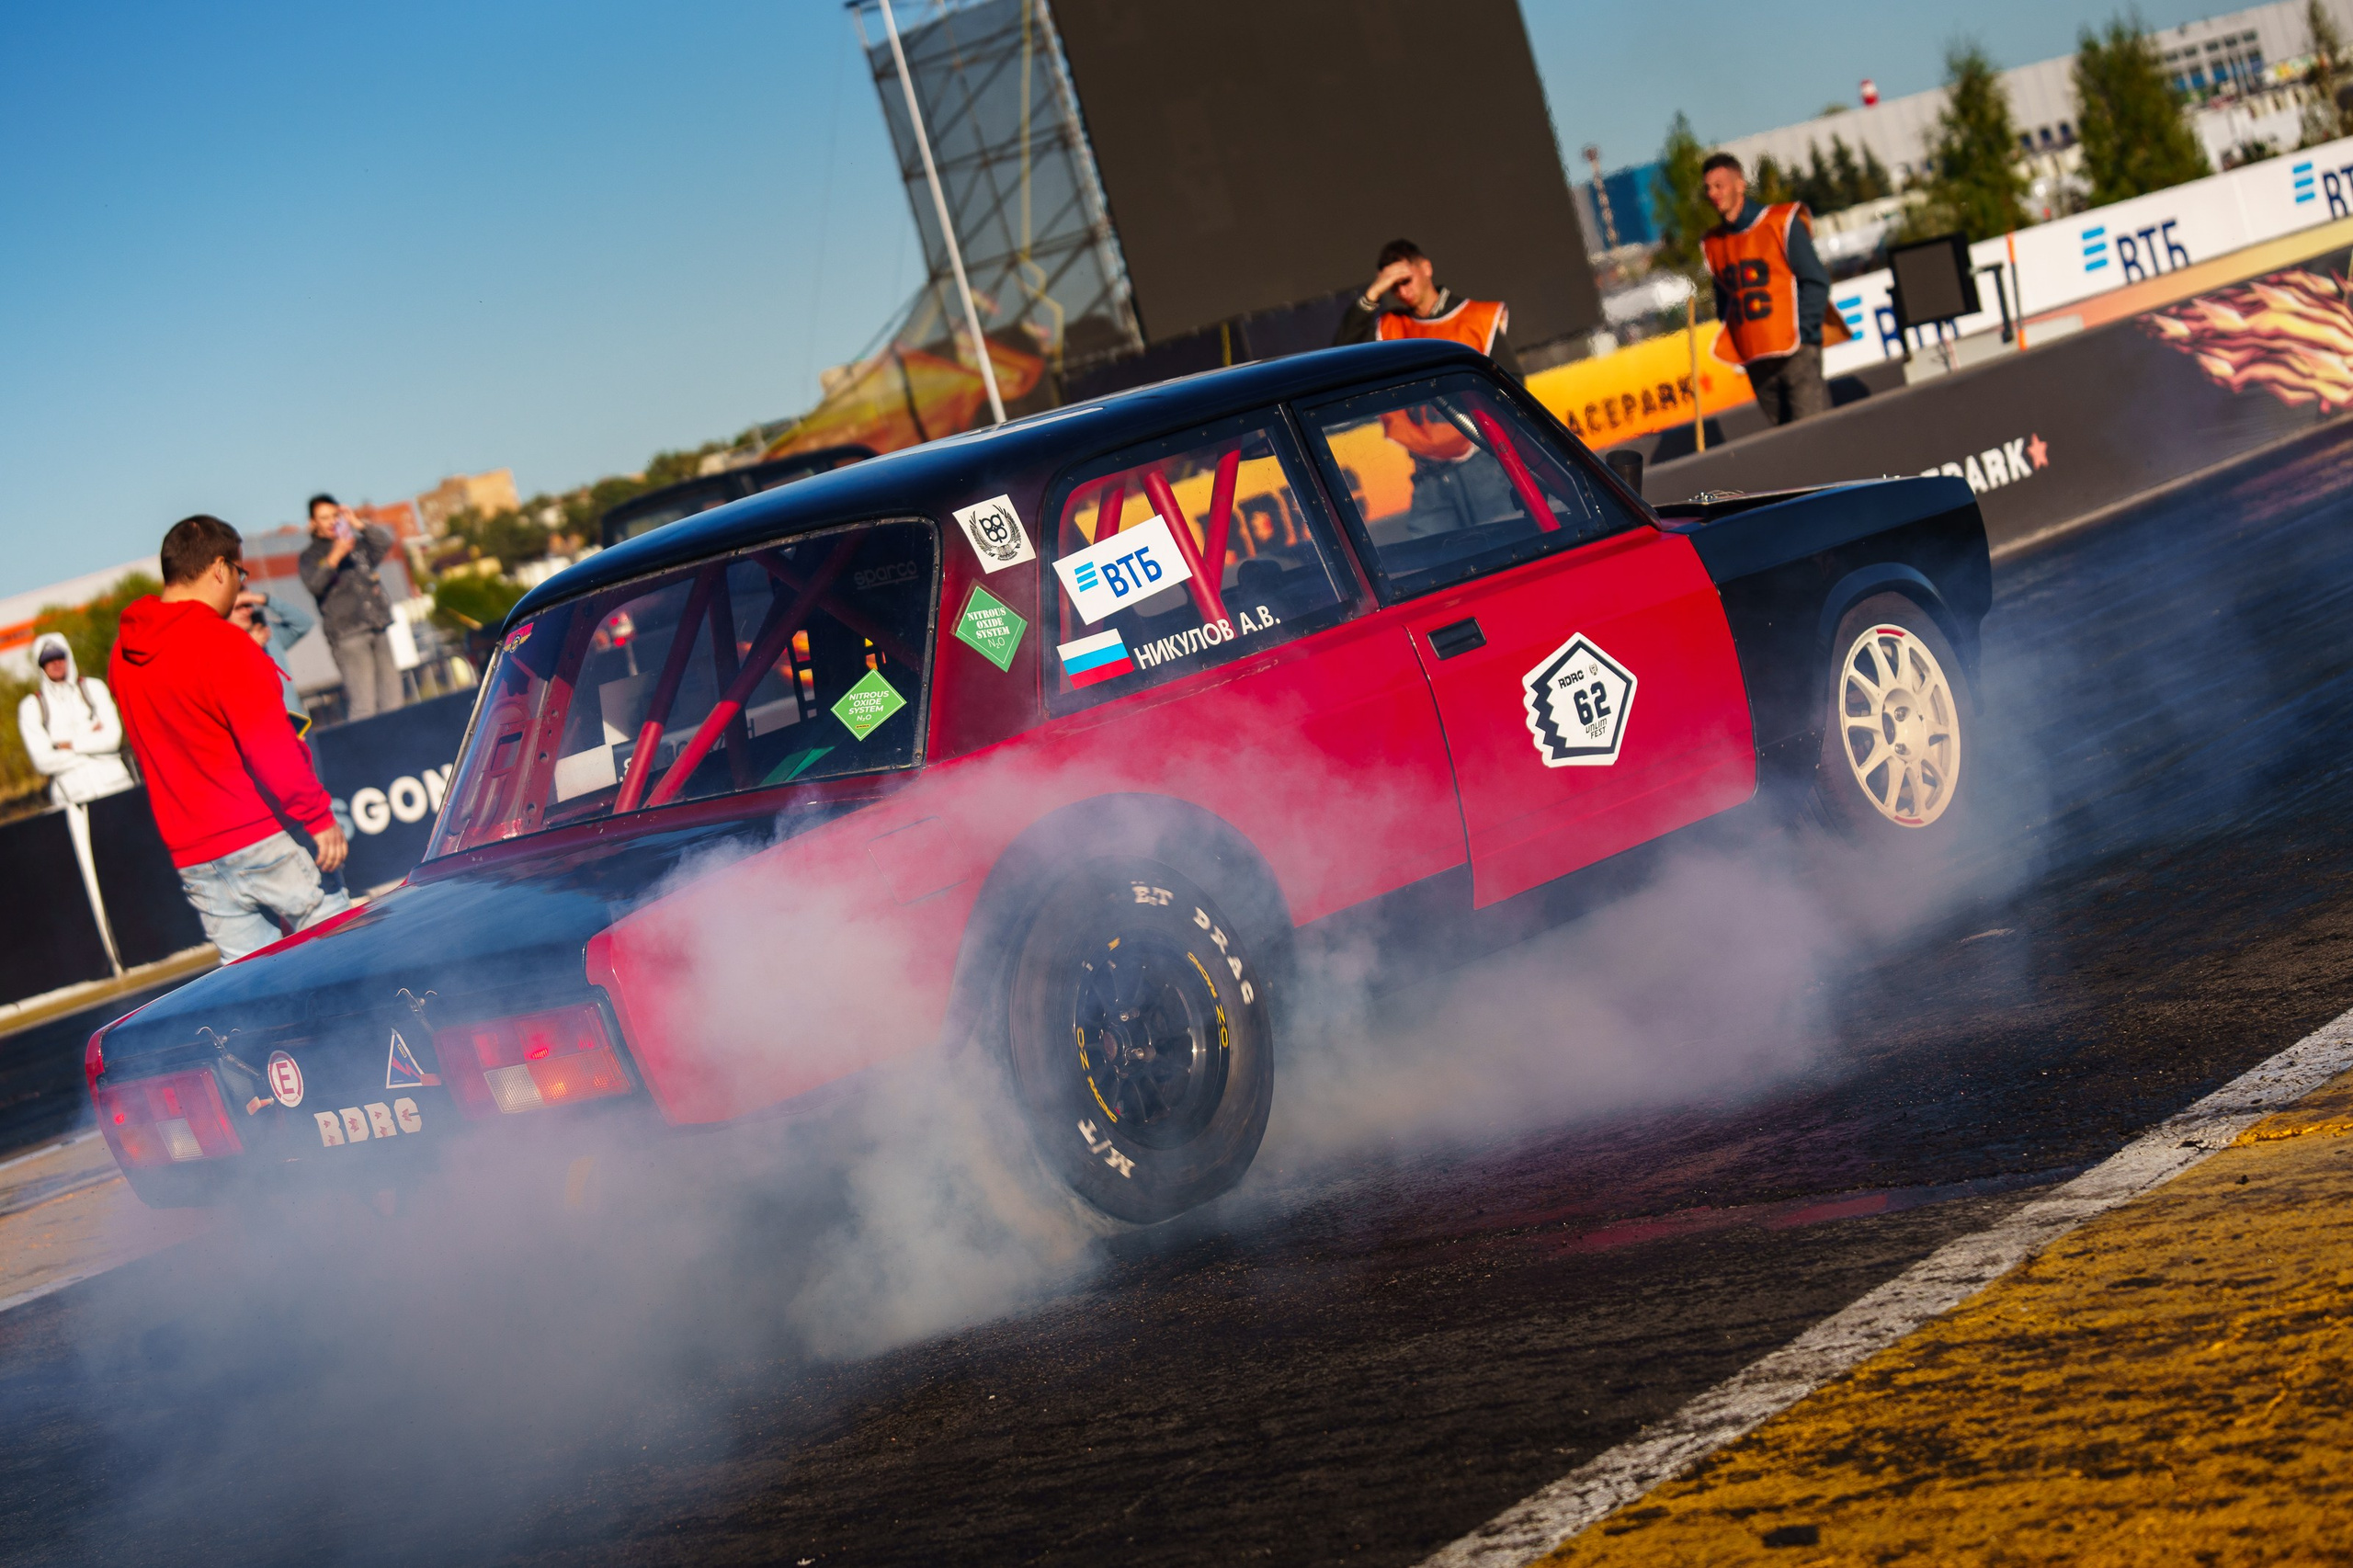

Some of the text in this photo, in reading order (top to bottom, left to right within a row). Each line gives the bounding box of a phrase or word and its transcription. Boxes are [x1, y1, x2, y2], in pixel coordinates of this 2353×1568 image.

[2117, 220, 2191, 285] ВТБ
[854, 561, 918, 589] sparco
[1100, 546, 1163, 597] ВТБ
[966, 607, 1006, 622] NITROUS
[976, 617, 1005, 630] OXIDE
[975, 626, 1011, 640] SYSTEM
[1133, 605, 1281, 670] НИКУЛОВ А.В.
[1558, 669, 1584, 688] RDRC
[848, 690, 889, 700] NITROUS
[853, 698, 881, 707] OXIDE
[1574, 681, 1611, 725] 62
[848, 705, 883, 714] SYSTEM
[1590, 726, 1606, 739] FEST
[1076, 1027, 1090, 1071] OZ
[276, 1062, 295, 1095] E
[313, 1096, 423, 1147] RDRC
